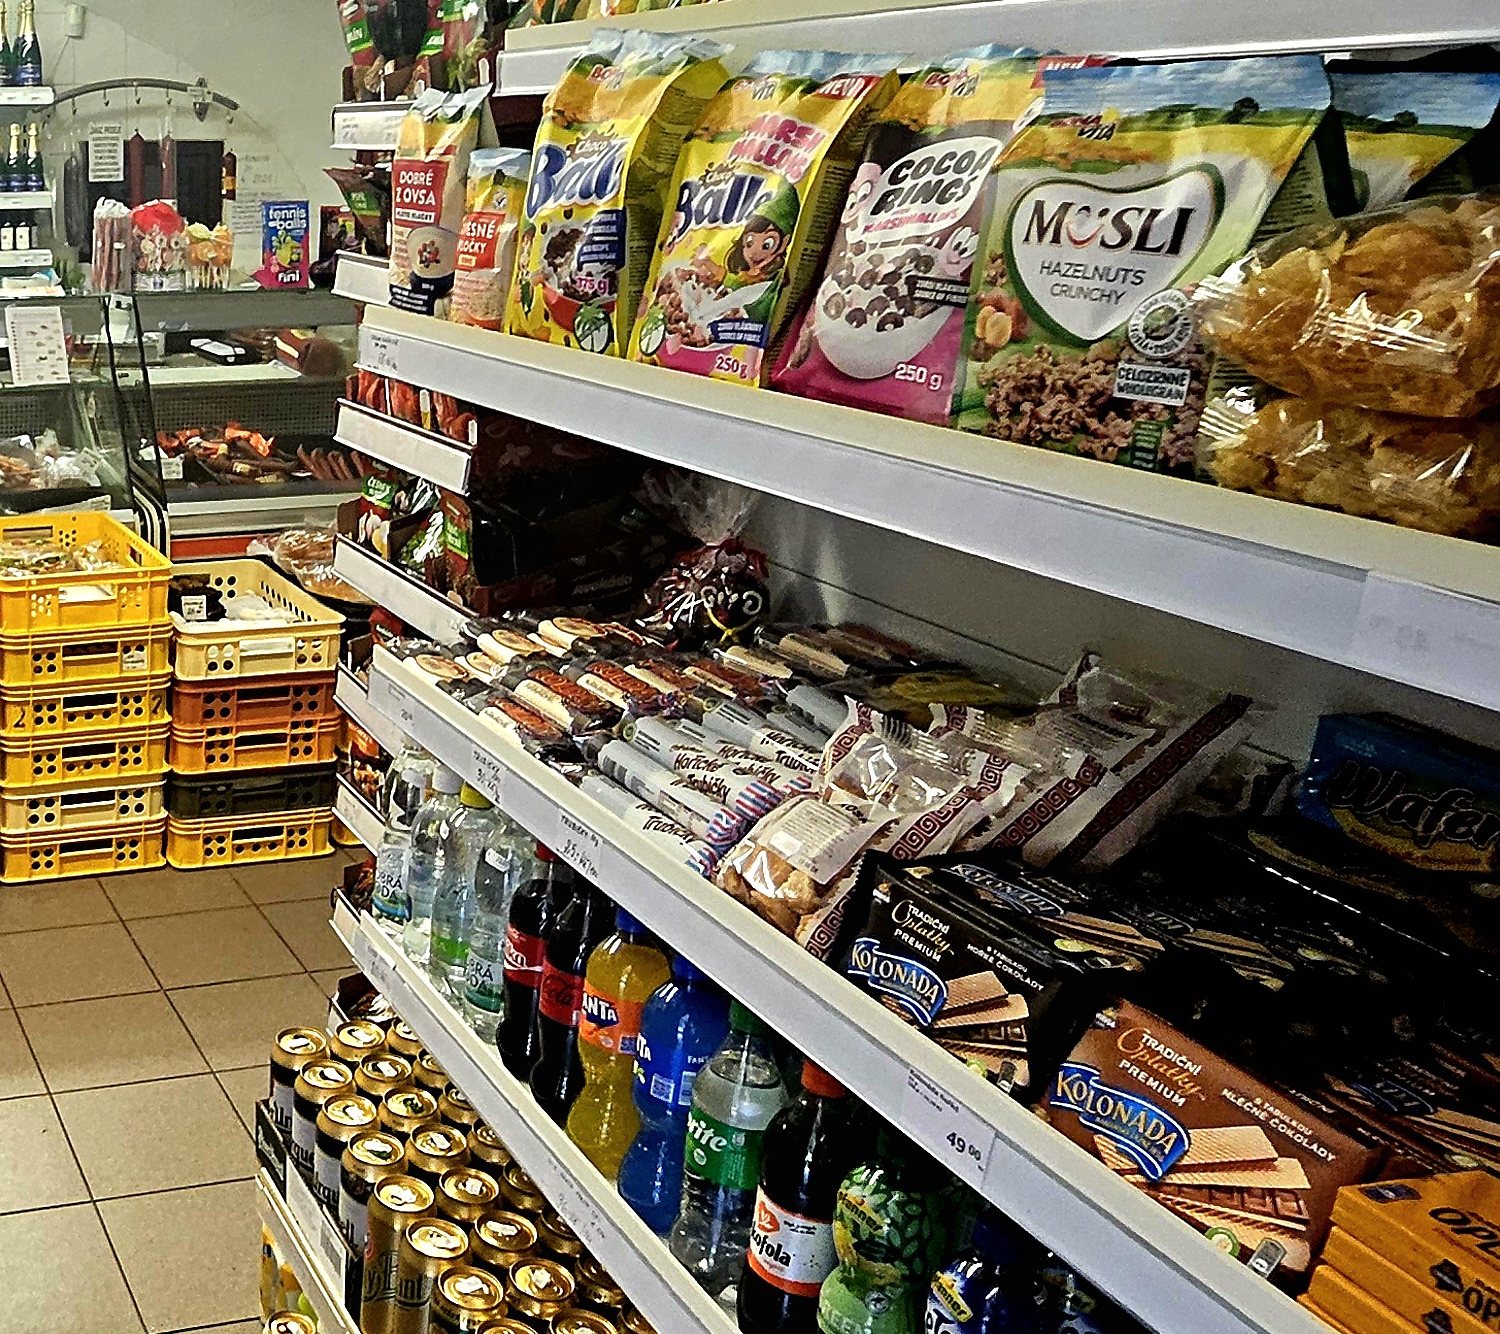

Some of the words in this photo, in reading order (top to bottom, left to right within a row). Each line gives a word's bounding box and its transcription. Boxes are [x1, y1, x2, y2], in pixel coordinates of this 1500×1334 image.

[399, 168, 435, 185] DOBRÉ
[888, 144, 996, 186] COCOA
[403, 188, 436, 206] OVSA
[870, 176, 978, 216] RINGS
[1039, 259, 1147, 287] HAZELNUTS
[1050, 282, 1127, 306] CRUNCHY
[895, 363, 926, 384] 250
[929, 372, 942, 393] g
[908, 904, 950, 935] TRADIČNÍ
[894, 928, 942, 963] PREMIUM
[582, 992, 619, 1024] ANTA
[1117, 1028, 1206, 1101] Oplatky
[1141, 1033, 1203, 1076] TRADIČNÍ
[1119, 1059, 1186, 1107] PREMIUM
[947, 1132, 966, 1153] 49
